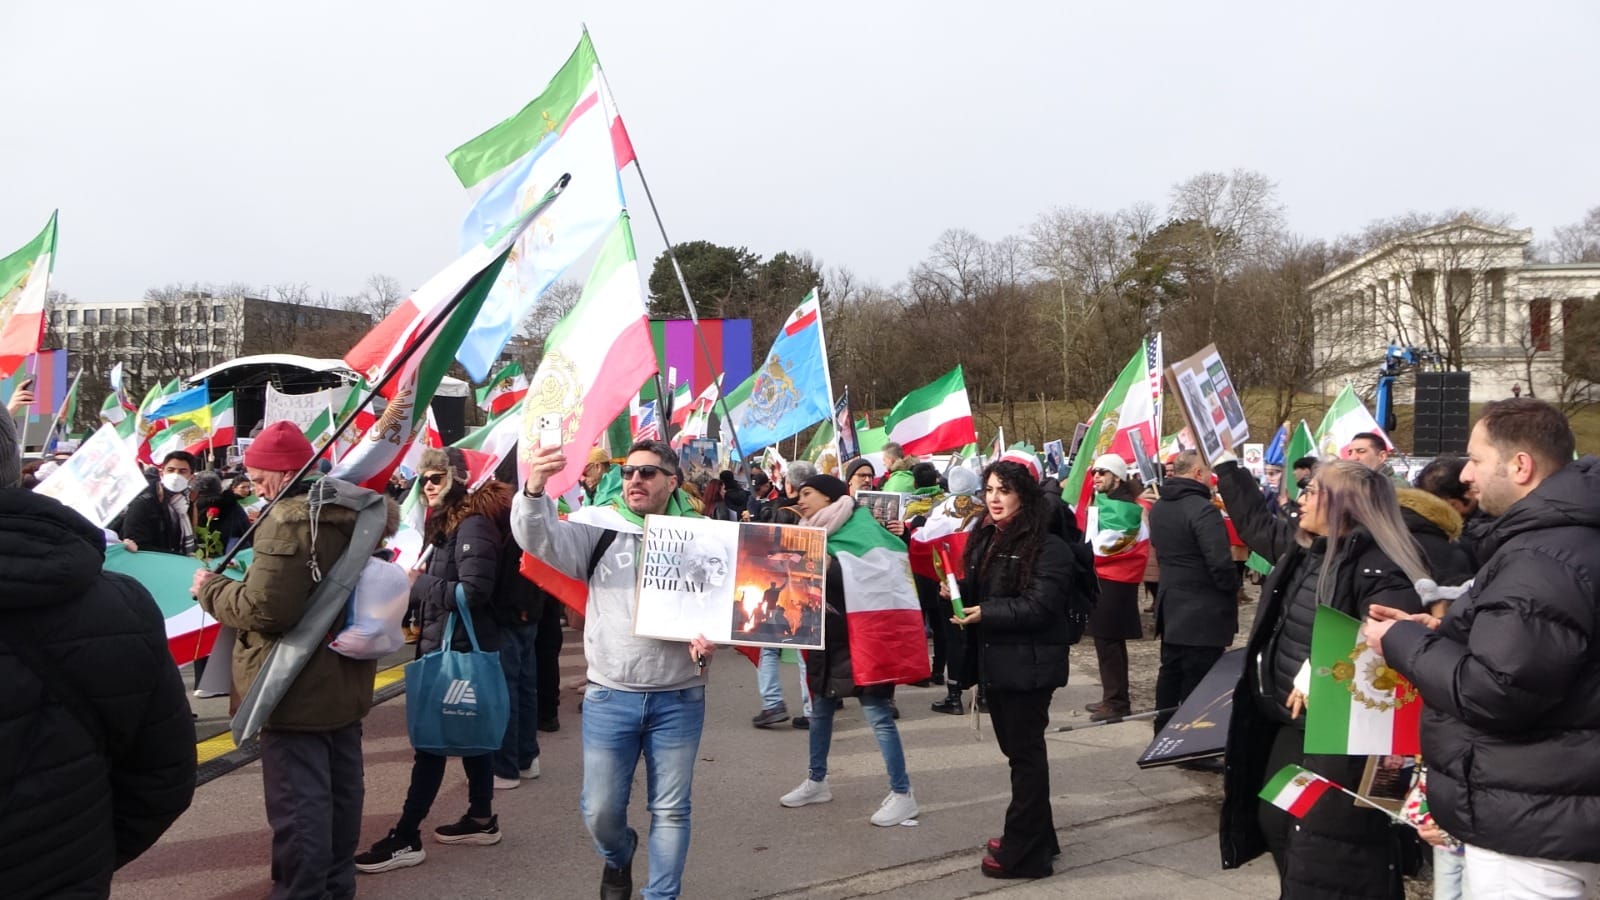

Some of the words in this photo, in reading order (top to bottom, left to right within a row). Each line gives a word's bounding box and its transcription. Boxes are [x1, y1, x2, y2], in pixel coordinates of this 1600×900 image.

[648, 528, 694, 541] STAND
[647, 540, 685, 553] WITH
[645, 552, 682, 565] KING
[644, 565, 681, 578] REZA
[643, 577, 704, 593] PAHLAVI
